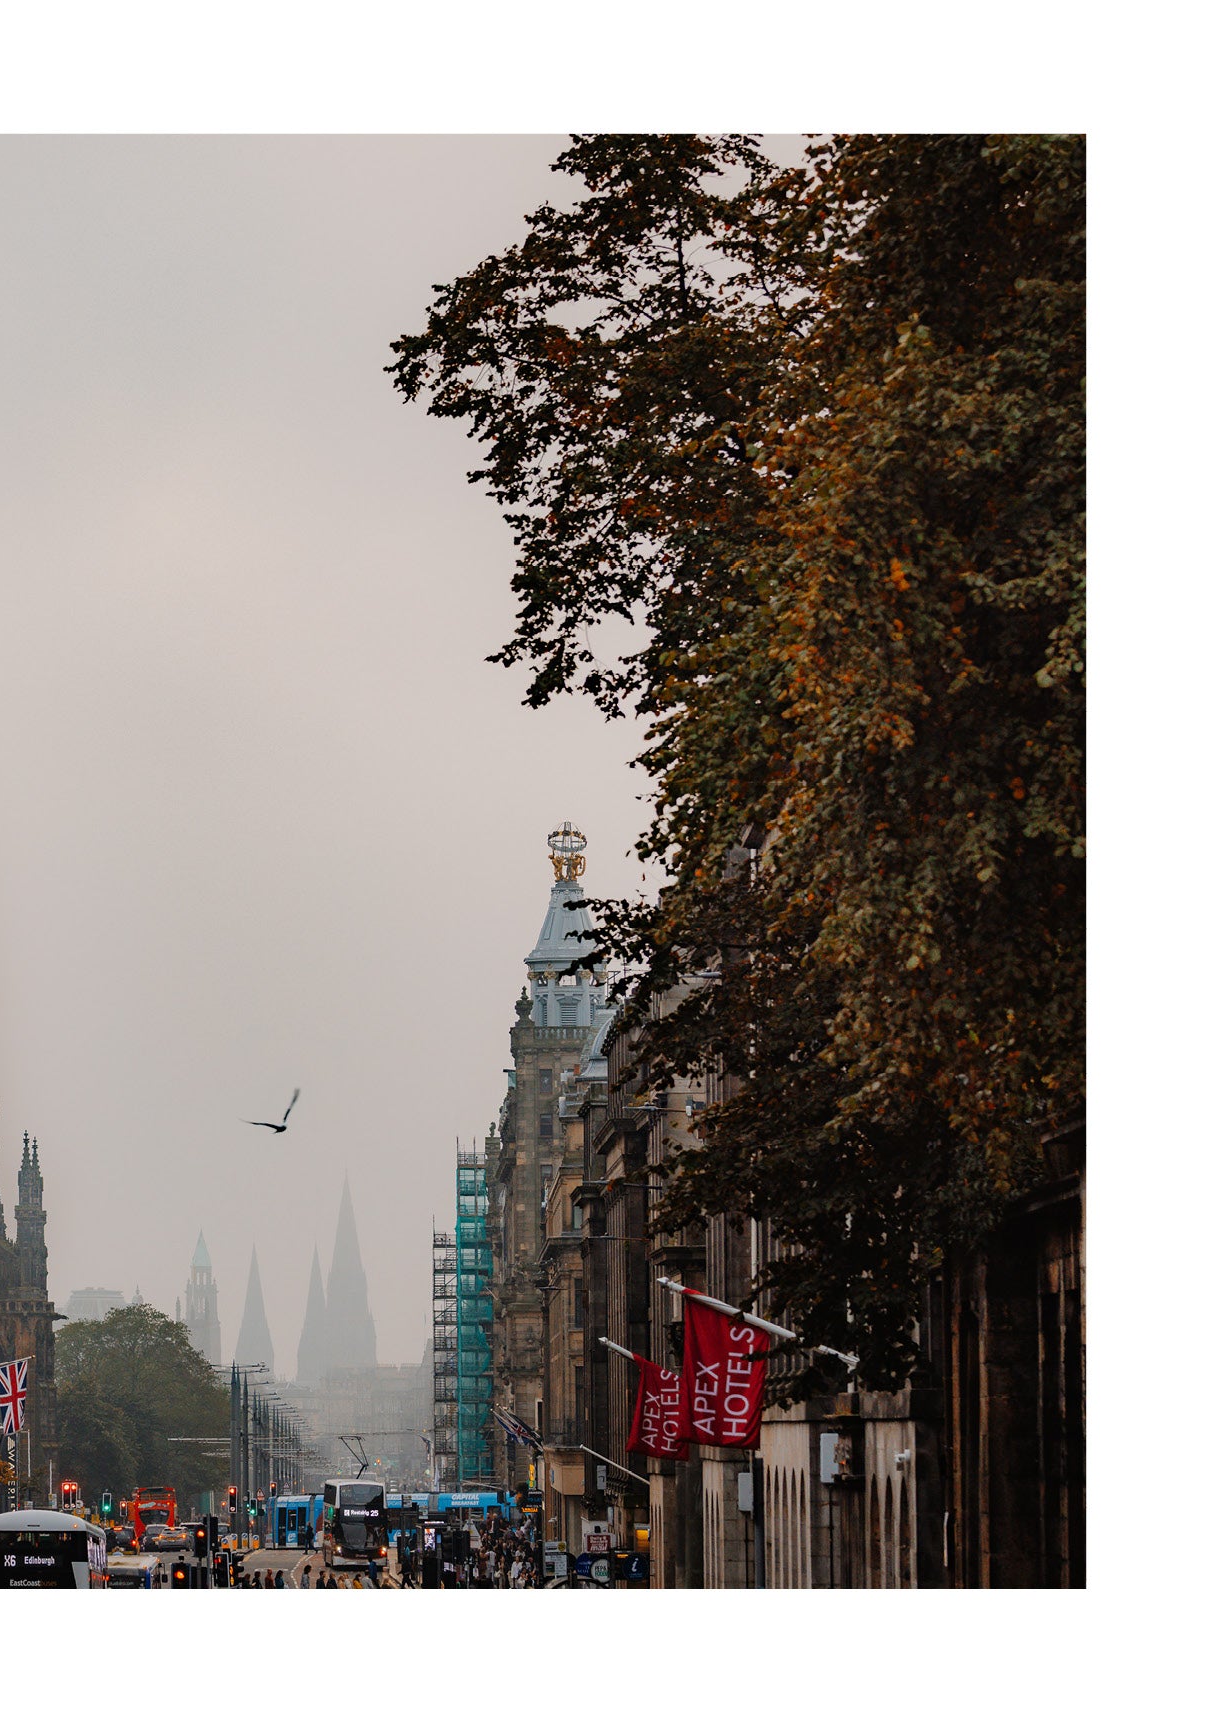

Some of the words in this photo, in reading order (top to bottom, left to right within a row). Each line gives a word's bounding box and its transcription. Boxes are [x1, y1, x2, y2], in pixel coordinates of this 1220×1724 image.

[692, 1361, 720, 1436] APEX
[722, 1327, 755, 1437] HOTELS
[641, 1391, 661, 1448] APEX
[451, 1493, 479, 1501] CAPITAL
[4, 1555, 16, 1567] X6
[24, 1556, 55, 1567] Edinburgh
